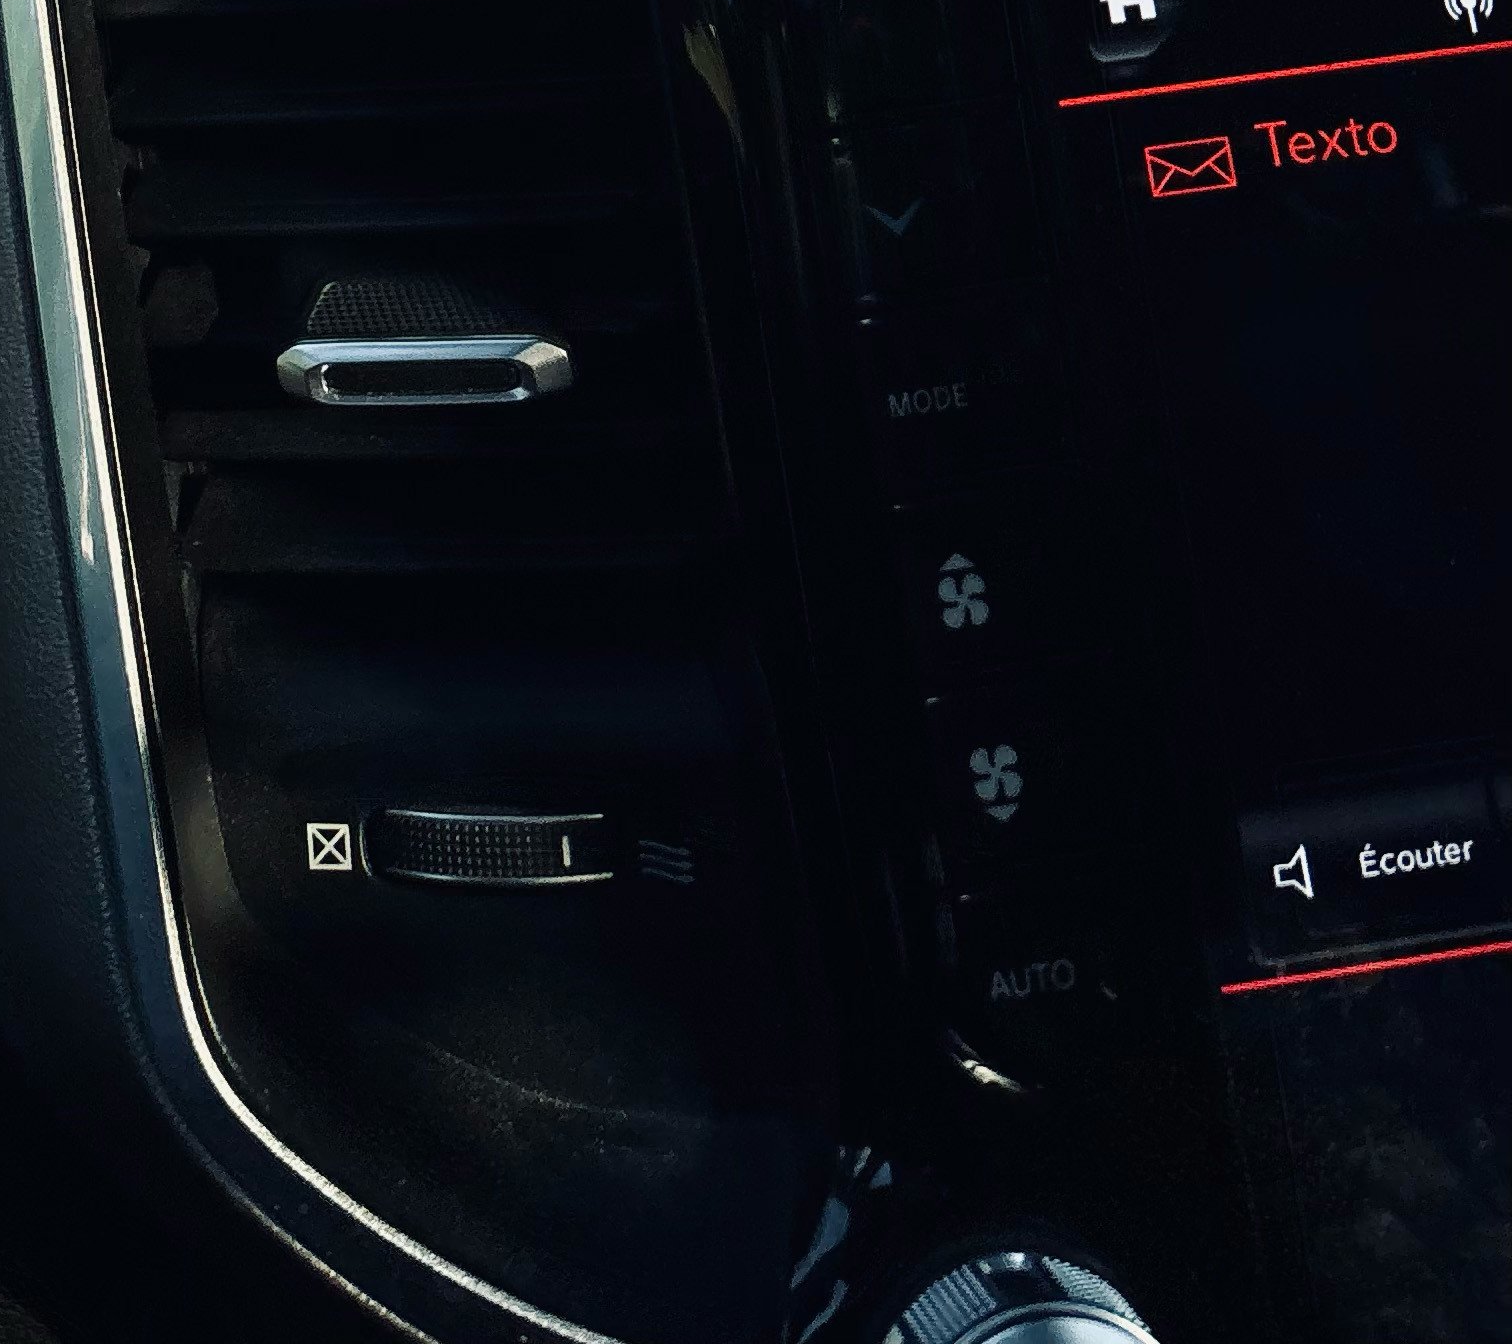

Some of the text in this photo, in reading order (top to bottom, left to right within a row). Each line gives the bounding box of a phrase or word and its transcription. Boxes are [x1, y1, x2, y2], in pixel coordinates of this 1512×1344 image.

[1253, 118, 1399, 169] Texto
[888, 382, 968, 417] MODE
[1359, 840, 1474, 879] Écouter
[990, 958, 1075, 1002] AUTO
